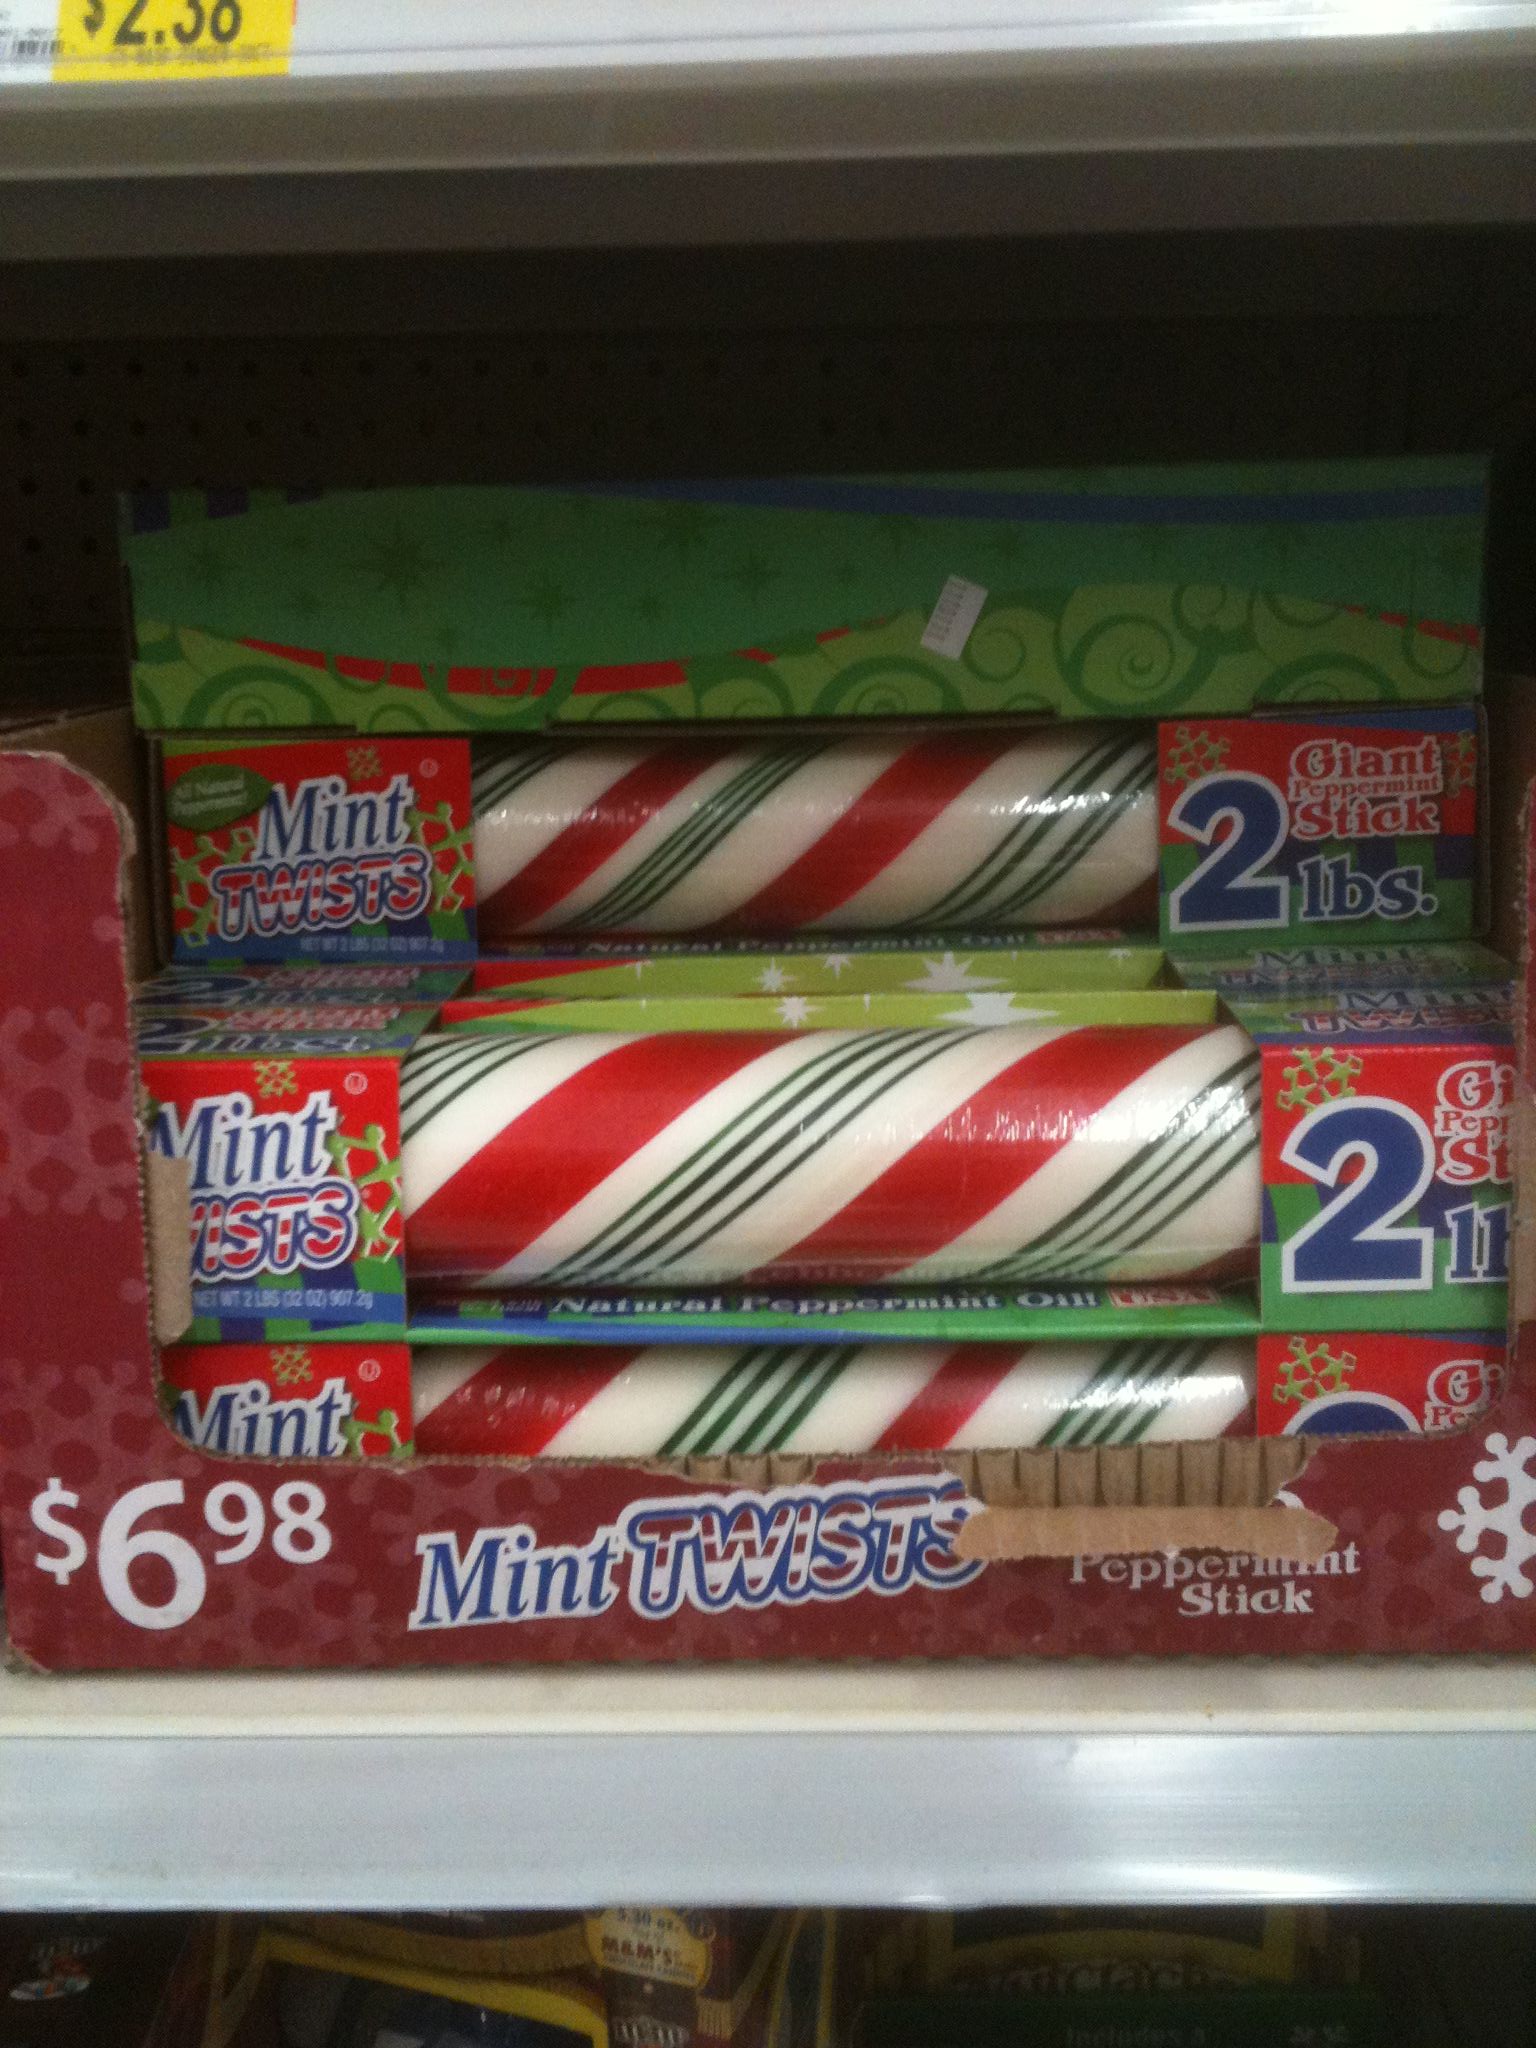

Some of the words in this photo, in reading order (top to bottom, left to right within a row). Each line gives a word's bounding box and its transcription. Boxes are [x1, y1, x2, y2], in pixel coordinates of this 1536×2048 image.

[1289, 736, 1442, 783] Giant
[1290, 776, 1442, 799] Peppermint
[259, 775, 414, 861] Mint
[1167, 770, 1290, 932] 2
[1298, 852, 1438, 921] lbs.
[1290, 796, 1440, 840] Stick
[209, 844, 433, 942] TWISTS
[151, 1089, 339, 1192] Mint
[190, 1178, 361, 1283] ISTS
[1280, 1095, 1436, 1293] 2
[550, 1296, 724, 1314] Natural
[739, 1292, 1002, 1316] Peppermint
[174, 1376, 353, 1458] Mint
[407, 1522, 627, 1631] Mint
[618, 1470, 988, 1620] TWISTS
[1177, 1578, 1314, 1616] Stick
